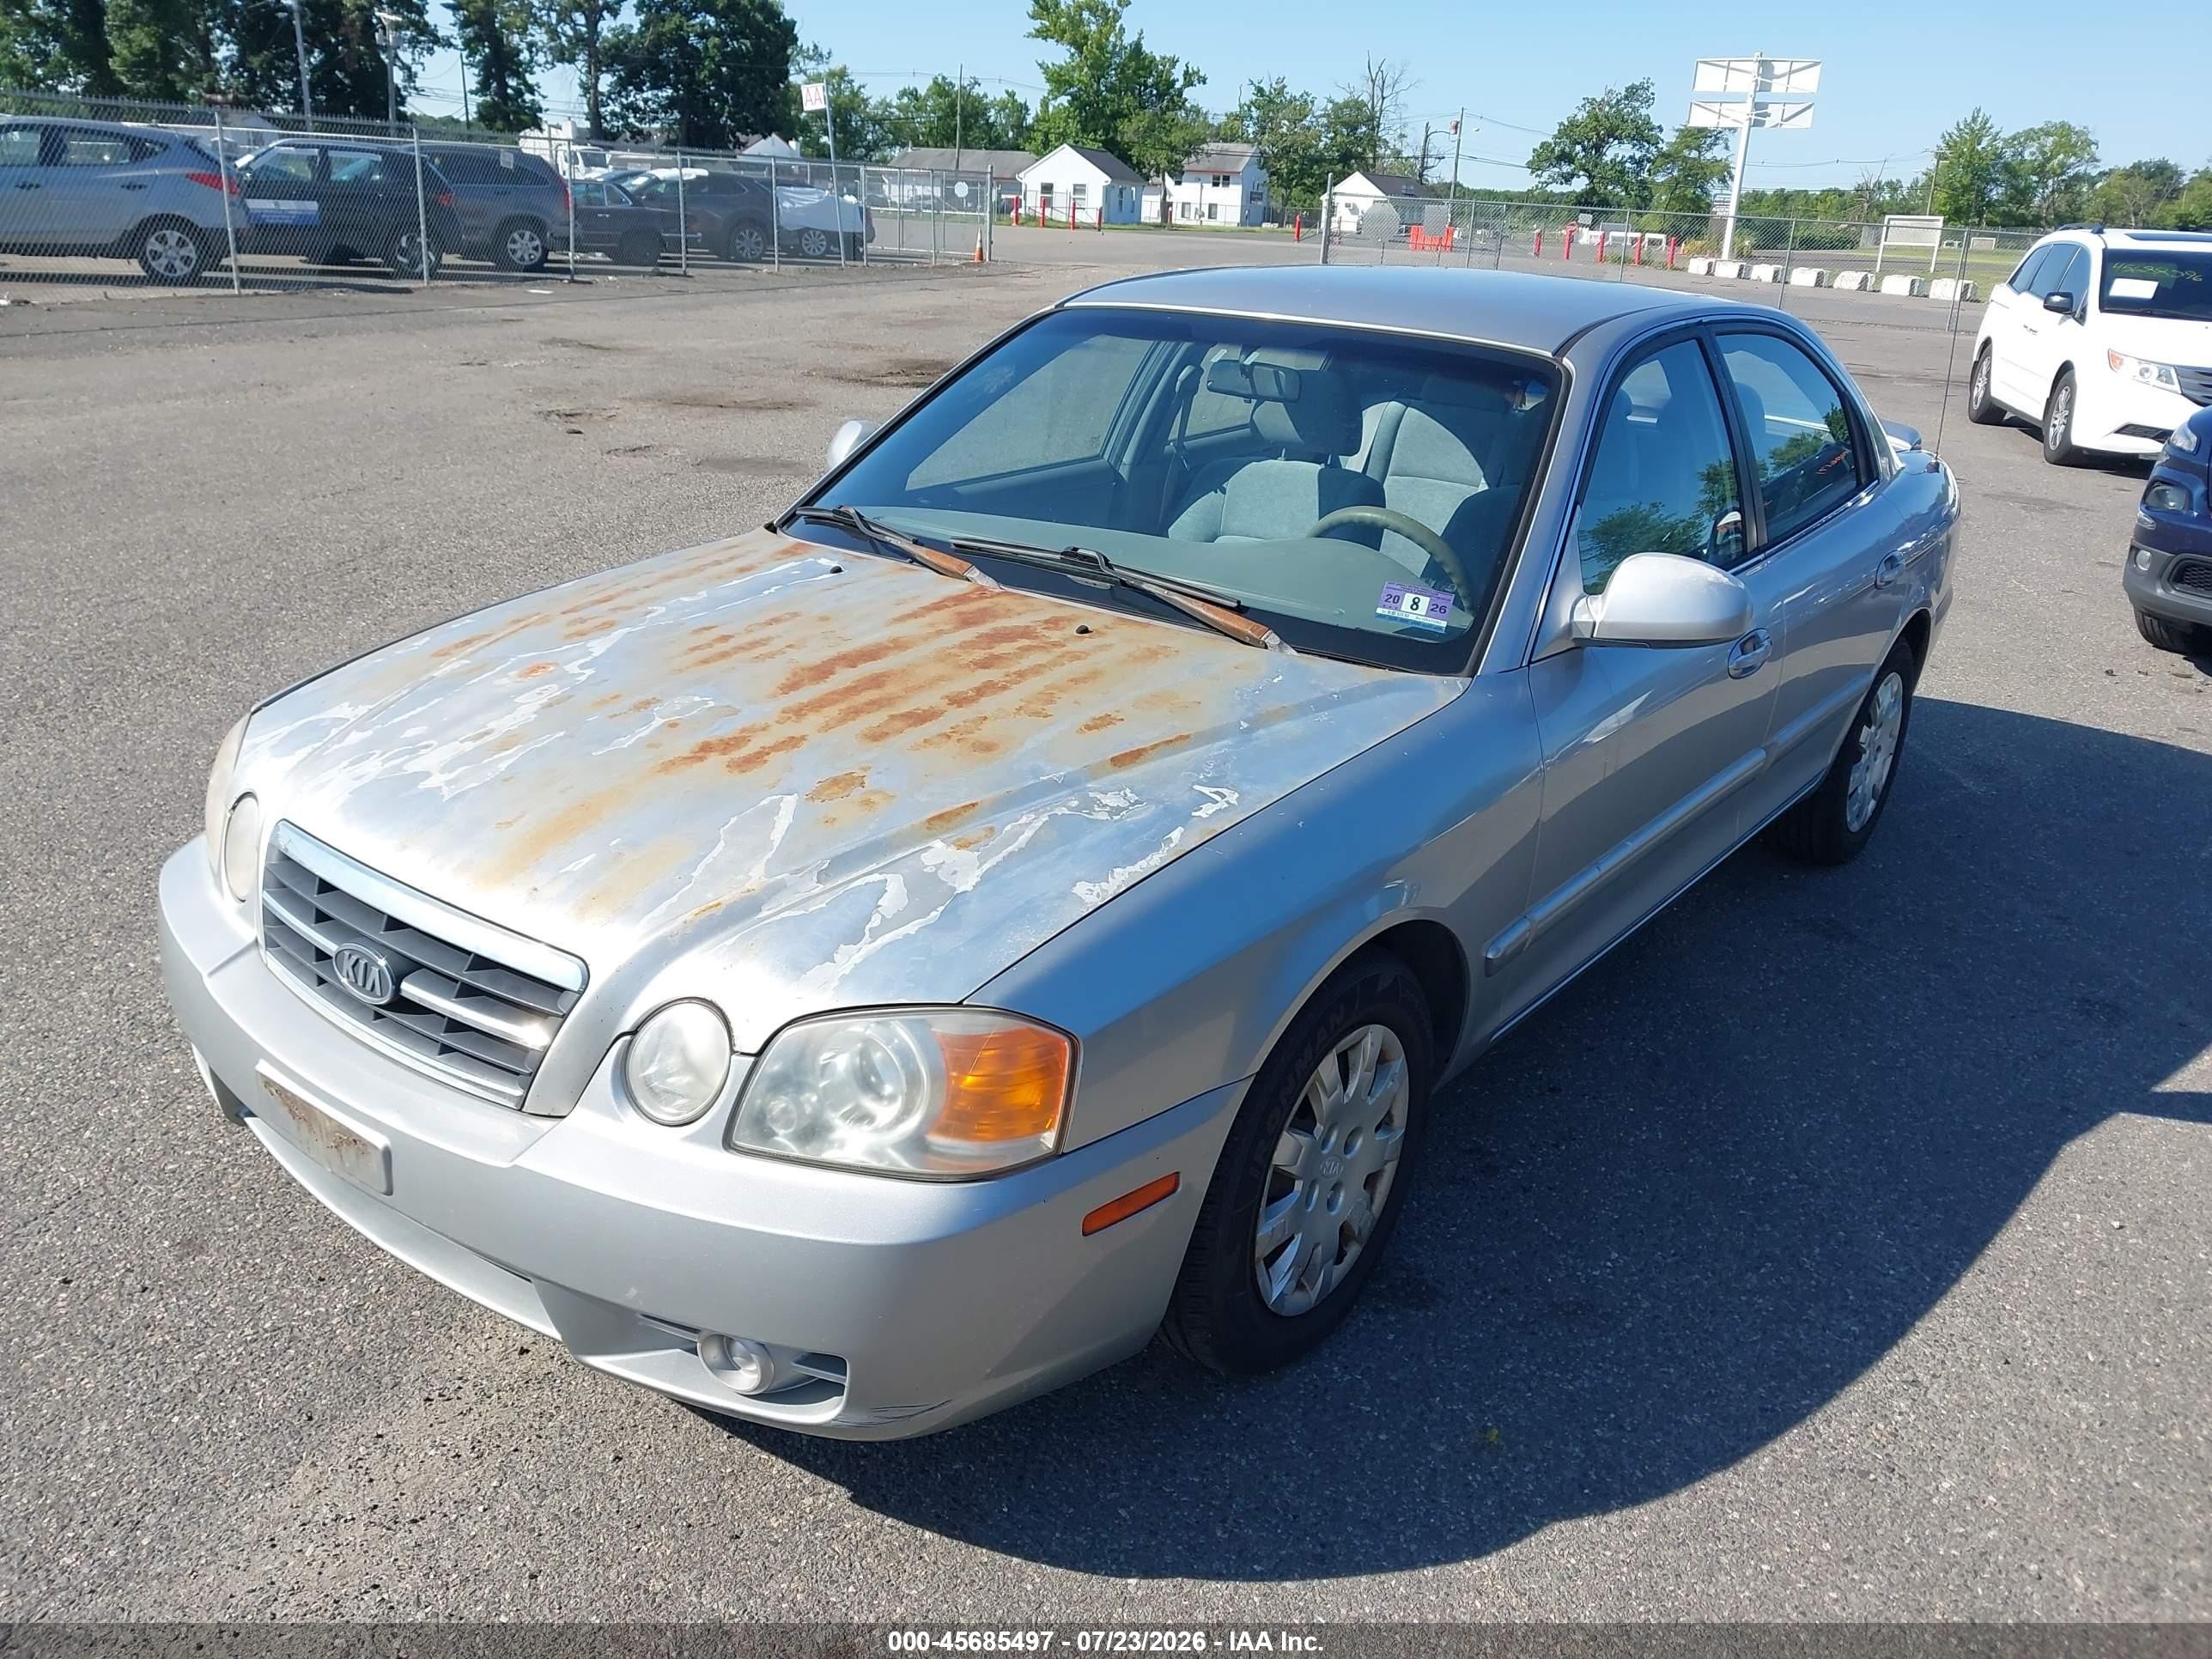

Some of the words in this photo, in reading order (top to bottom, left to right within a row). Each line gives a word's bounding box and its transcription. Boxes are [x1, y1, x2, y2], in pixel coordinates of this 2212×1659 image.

[805, 87, 823, 106] AA
[1385, 593, 1401, 604] 20
[1410, 597, 1421, 610] 8
[1431, 604, 1447, 614] 26
[342, 951, 382, 997] KIA
